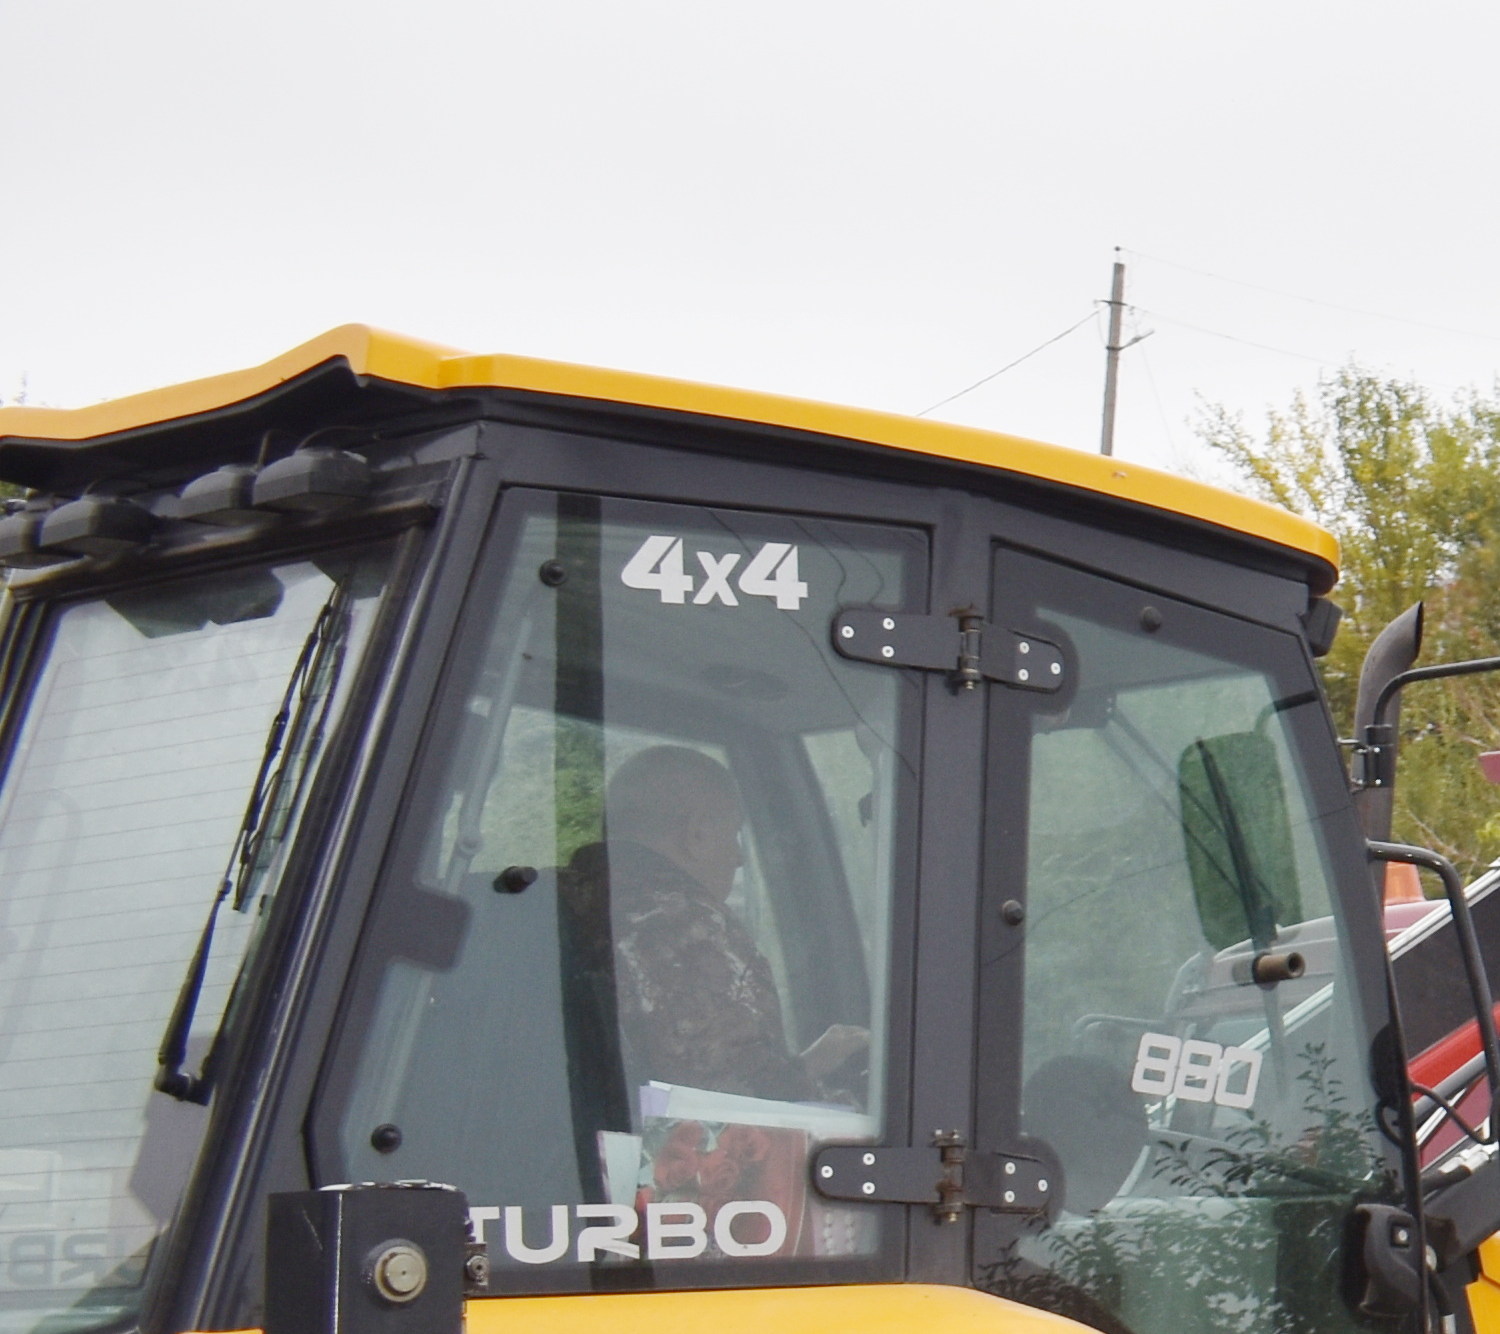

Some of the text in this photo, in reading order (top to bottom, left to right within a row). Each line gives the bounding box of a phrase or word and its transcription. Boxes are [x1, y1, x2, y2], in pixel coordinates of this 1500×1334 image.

[621, 535, 808, 610] 4x4
[1131, 1032, 1263, 1109] 880
[469, 1200, 787, 1264] TURBO
